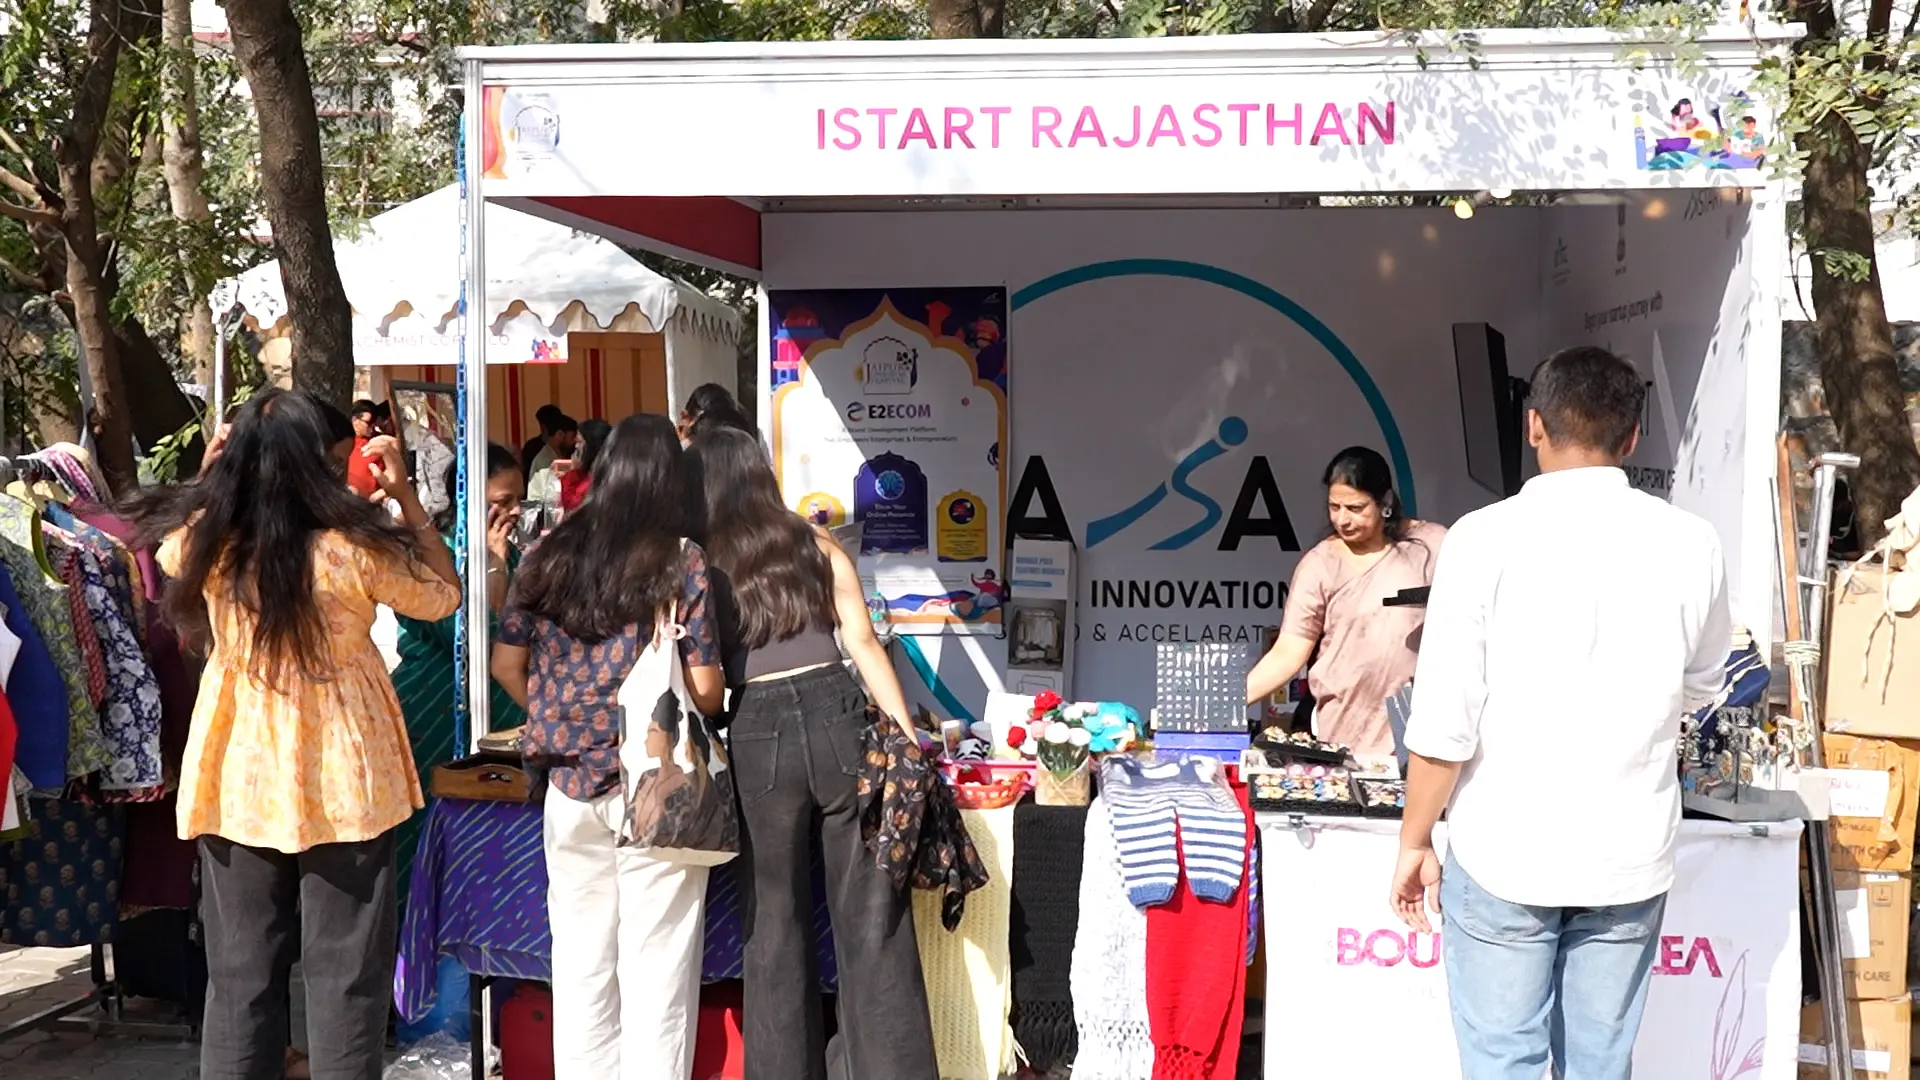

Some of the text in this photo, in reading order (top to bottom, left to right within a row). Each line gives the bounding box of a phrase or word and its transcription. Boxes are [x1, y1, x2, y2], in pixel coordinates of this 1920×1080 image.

[817, 101, 1395, 151] ISTART RAJASTHAN
[355, 335, 424, 347] LCHEMIST
[868, 404, 931, 419] E2ECOM
[1093, 623, 1107, 642] &
[1118, 623, 1278, 643] ACCELARAT
[1337, 927, 1723, 978] BOU EA
[1863, 970, 1892, 982] CARE
